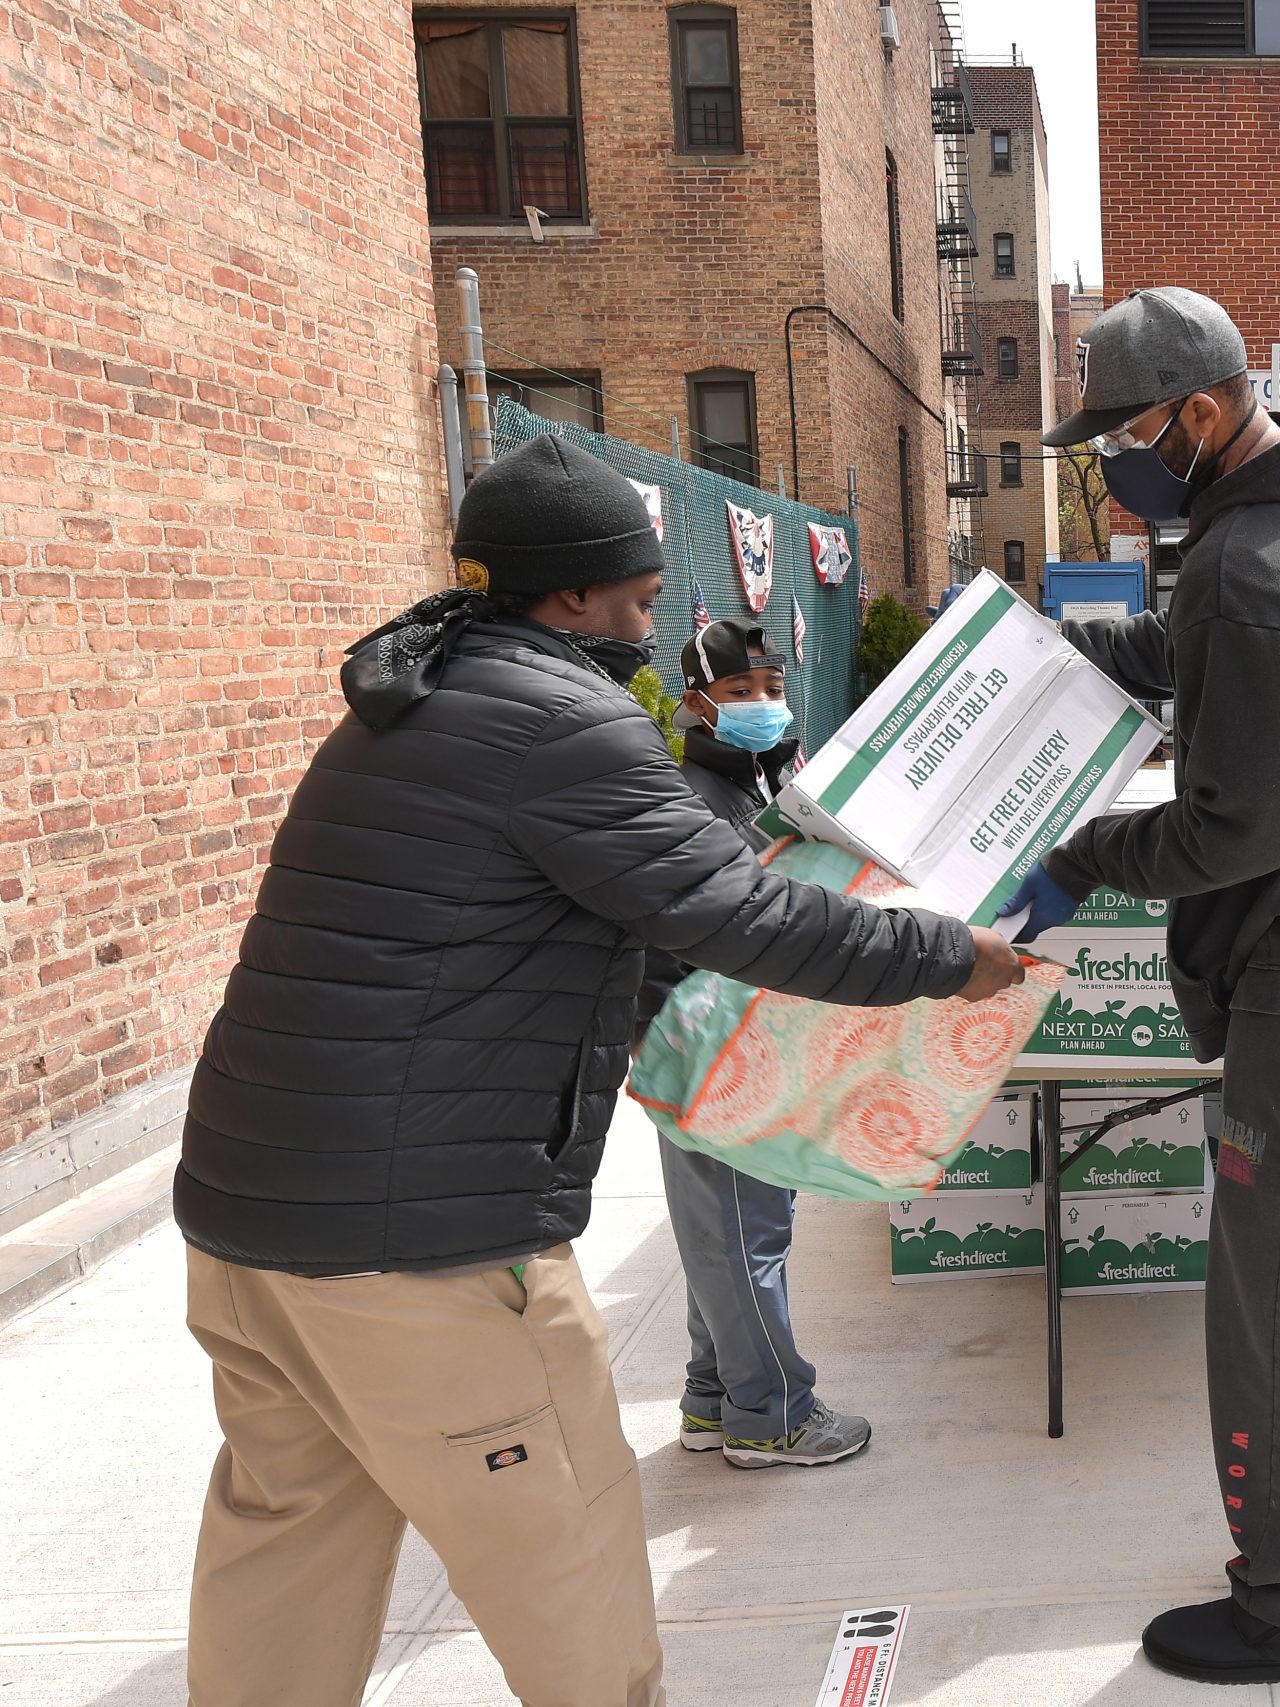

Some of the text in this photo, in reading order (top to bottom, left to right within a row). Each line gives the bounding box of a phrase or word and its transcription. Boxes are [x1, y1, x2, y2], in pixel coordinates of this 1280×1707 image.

[869, 639, 968, 753] FRESHDIRECT.COM/DELIVERYPASS
[903, 670, 978, 754] WITH DELIVERYPASS
[905, 668, 1008, 791] GET FREE DELIVERY
[970, 729, 1069, 853] GET FREE DELIVERY
[1001, 764, 1071, 849] WITH DELIVERYPASS
[1012, 765, 1102, 880] FRESHDIRECT.COM/DELIVERYPASS
[1105, 894, 1136, 907] DAY
[1073, 912, 1118, 921] PLAN AHEAD
[1075, 947, 1168, 981] freshdi
[1042, 1023, 1125, 1037] NEXT DAY
[1158, 1024, 1189, 1038] SAM
[1060, 1041, 1105, 1049] PLAN AHEAD
[936, 1169, 989, 1185] shdirect
[1088, 1167, 1161, 1185] freshdirect
[936, 1250, 1008, 1267] freshdirect
[1103, 1263, 1176, 1280] freshdirect
[880, 1649, 889, 1659] Ft.
[870, 1660, 886, 1698] DISTANCE
